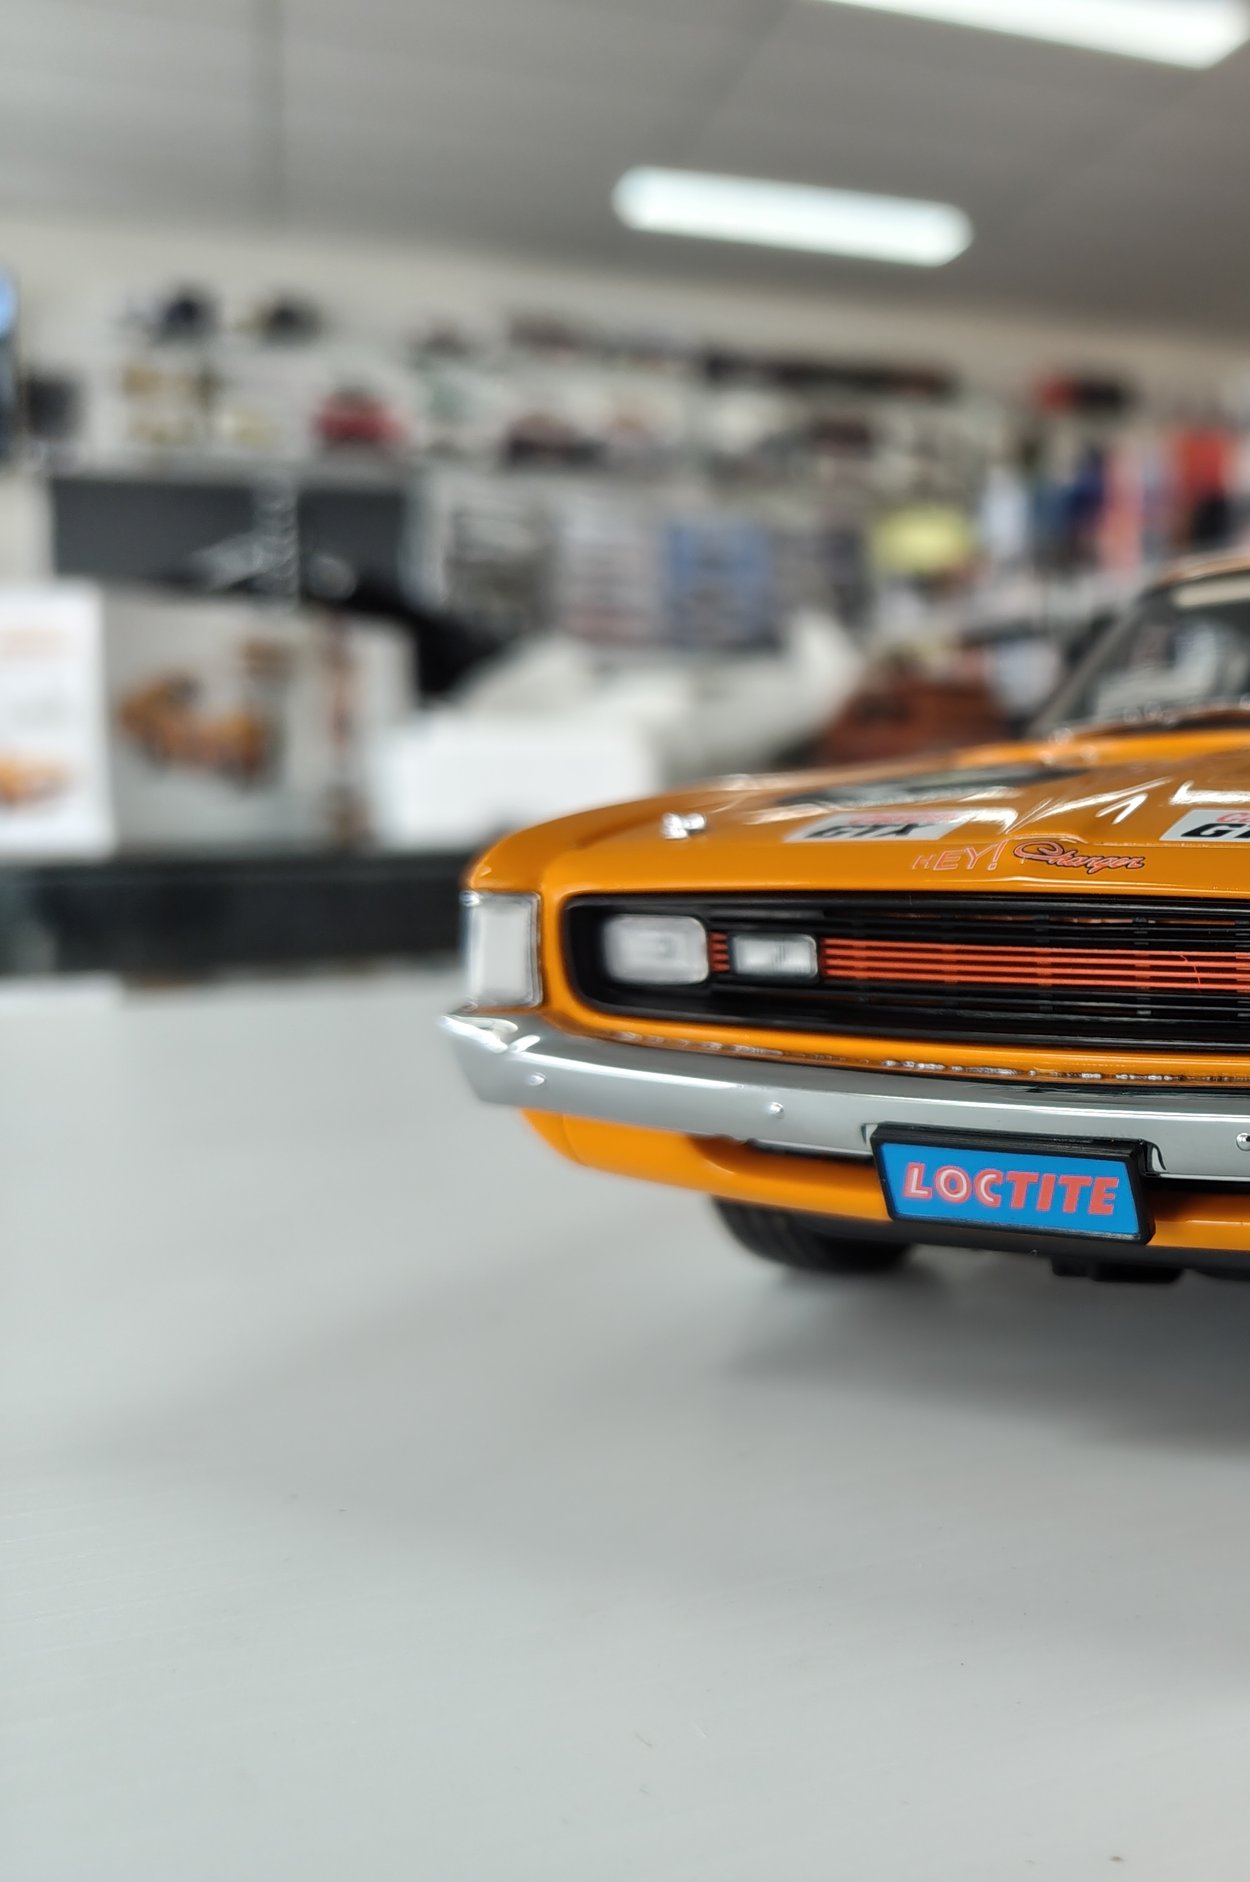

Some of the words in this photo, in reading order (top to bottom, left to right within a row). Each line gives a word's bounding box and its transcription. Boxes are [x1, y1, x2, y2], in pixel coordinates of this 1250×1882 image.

[804, 822, 935, 838] GTX
[912, 838, 1008, 871] HEY!
[1013, 839, 1146, 875] Charger
[903, 1162, 1119, 1215] LOCTITE
